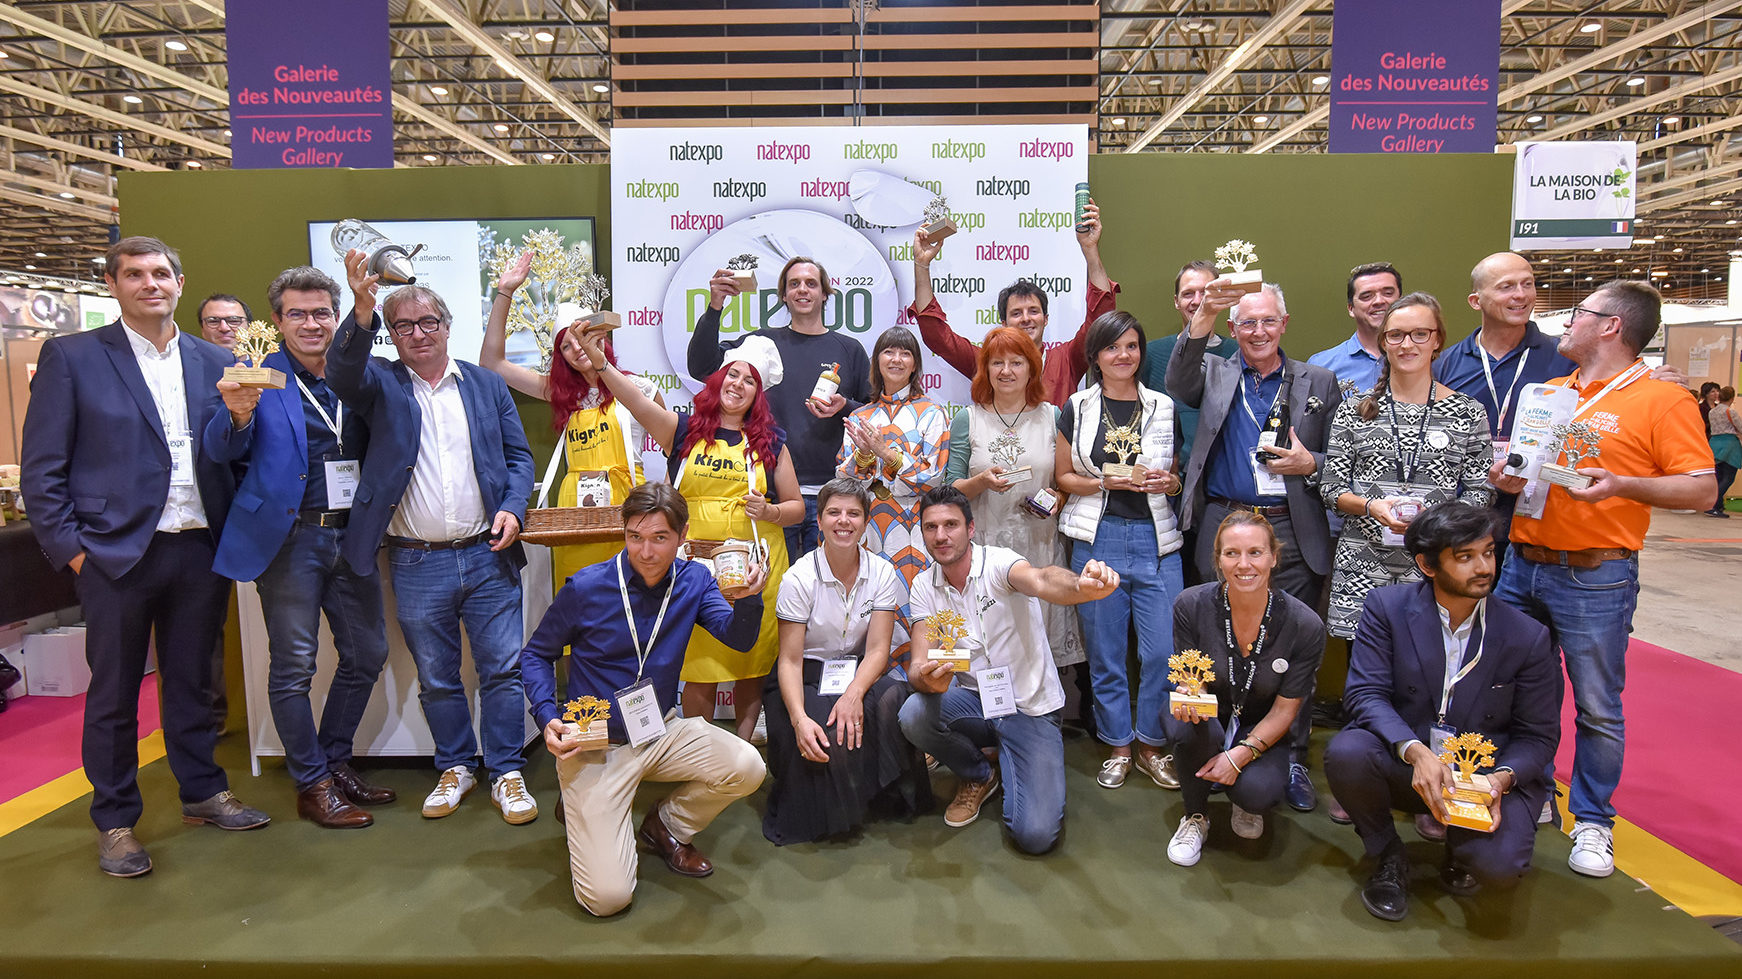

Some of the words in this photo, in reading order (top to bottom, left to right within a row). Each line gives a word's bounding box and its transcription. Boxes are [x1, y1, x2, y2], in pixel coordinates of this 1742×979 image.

[1380, 52, 1447, 70] Galerie
[274, 64, 339, 83] Galerie
[1340, 74, 1372, 91] des
[1378, 73, 1489, 91] Nouveautés
[238, 87, 269, 105] des
[273, 86, 383, 104] Nouveautés
[1351, 113, 1392, 130] New
[1397, 112, 1476, 130] Products
[251, 126, 291, 144] New
[295, 125, 373, 143] Products
[1381, 135, 1445, 153] Gallery
[282, 147, 344, 167] Gallery
[669, 140, 723, 165] natexpo
[756, 140, 811, 164] natexpo
[844, 139, 898, 164] natexpo
[931, 138, 986, 163] natexpo
[1019, 137, 1074, 162] natexpo
[626, 178, 680, 202] natexpo
[713, 177, 766, 202] natexpo
[976, 176, 1030, 200] natexpo
[1530, 175, 1546, 187] LA
[1548, 174, 1602, 187] MAISON
[1604, 174, 1621, 187] DE
[1554, 189, 1571, 201] LA
[1573, 188, 1596, 201] BIO
[670, 210, 724, 234] natexpo
[1018, 208, 1072, 232] natexpo
[419, 253, 453, 262] attention.
[627, 242, 680, 267] natexpo
[976, 240, 1030, 265] natexpo
[845, 276, 874, 286] 2022
[932, 273, 985, 297] natexpo
[628, 306, 663, 326] natex
[686, 287, 873, 333] natepo
